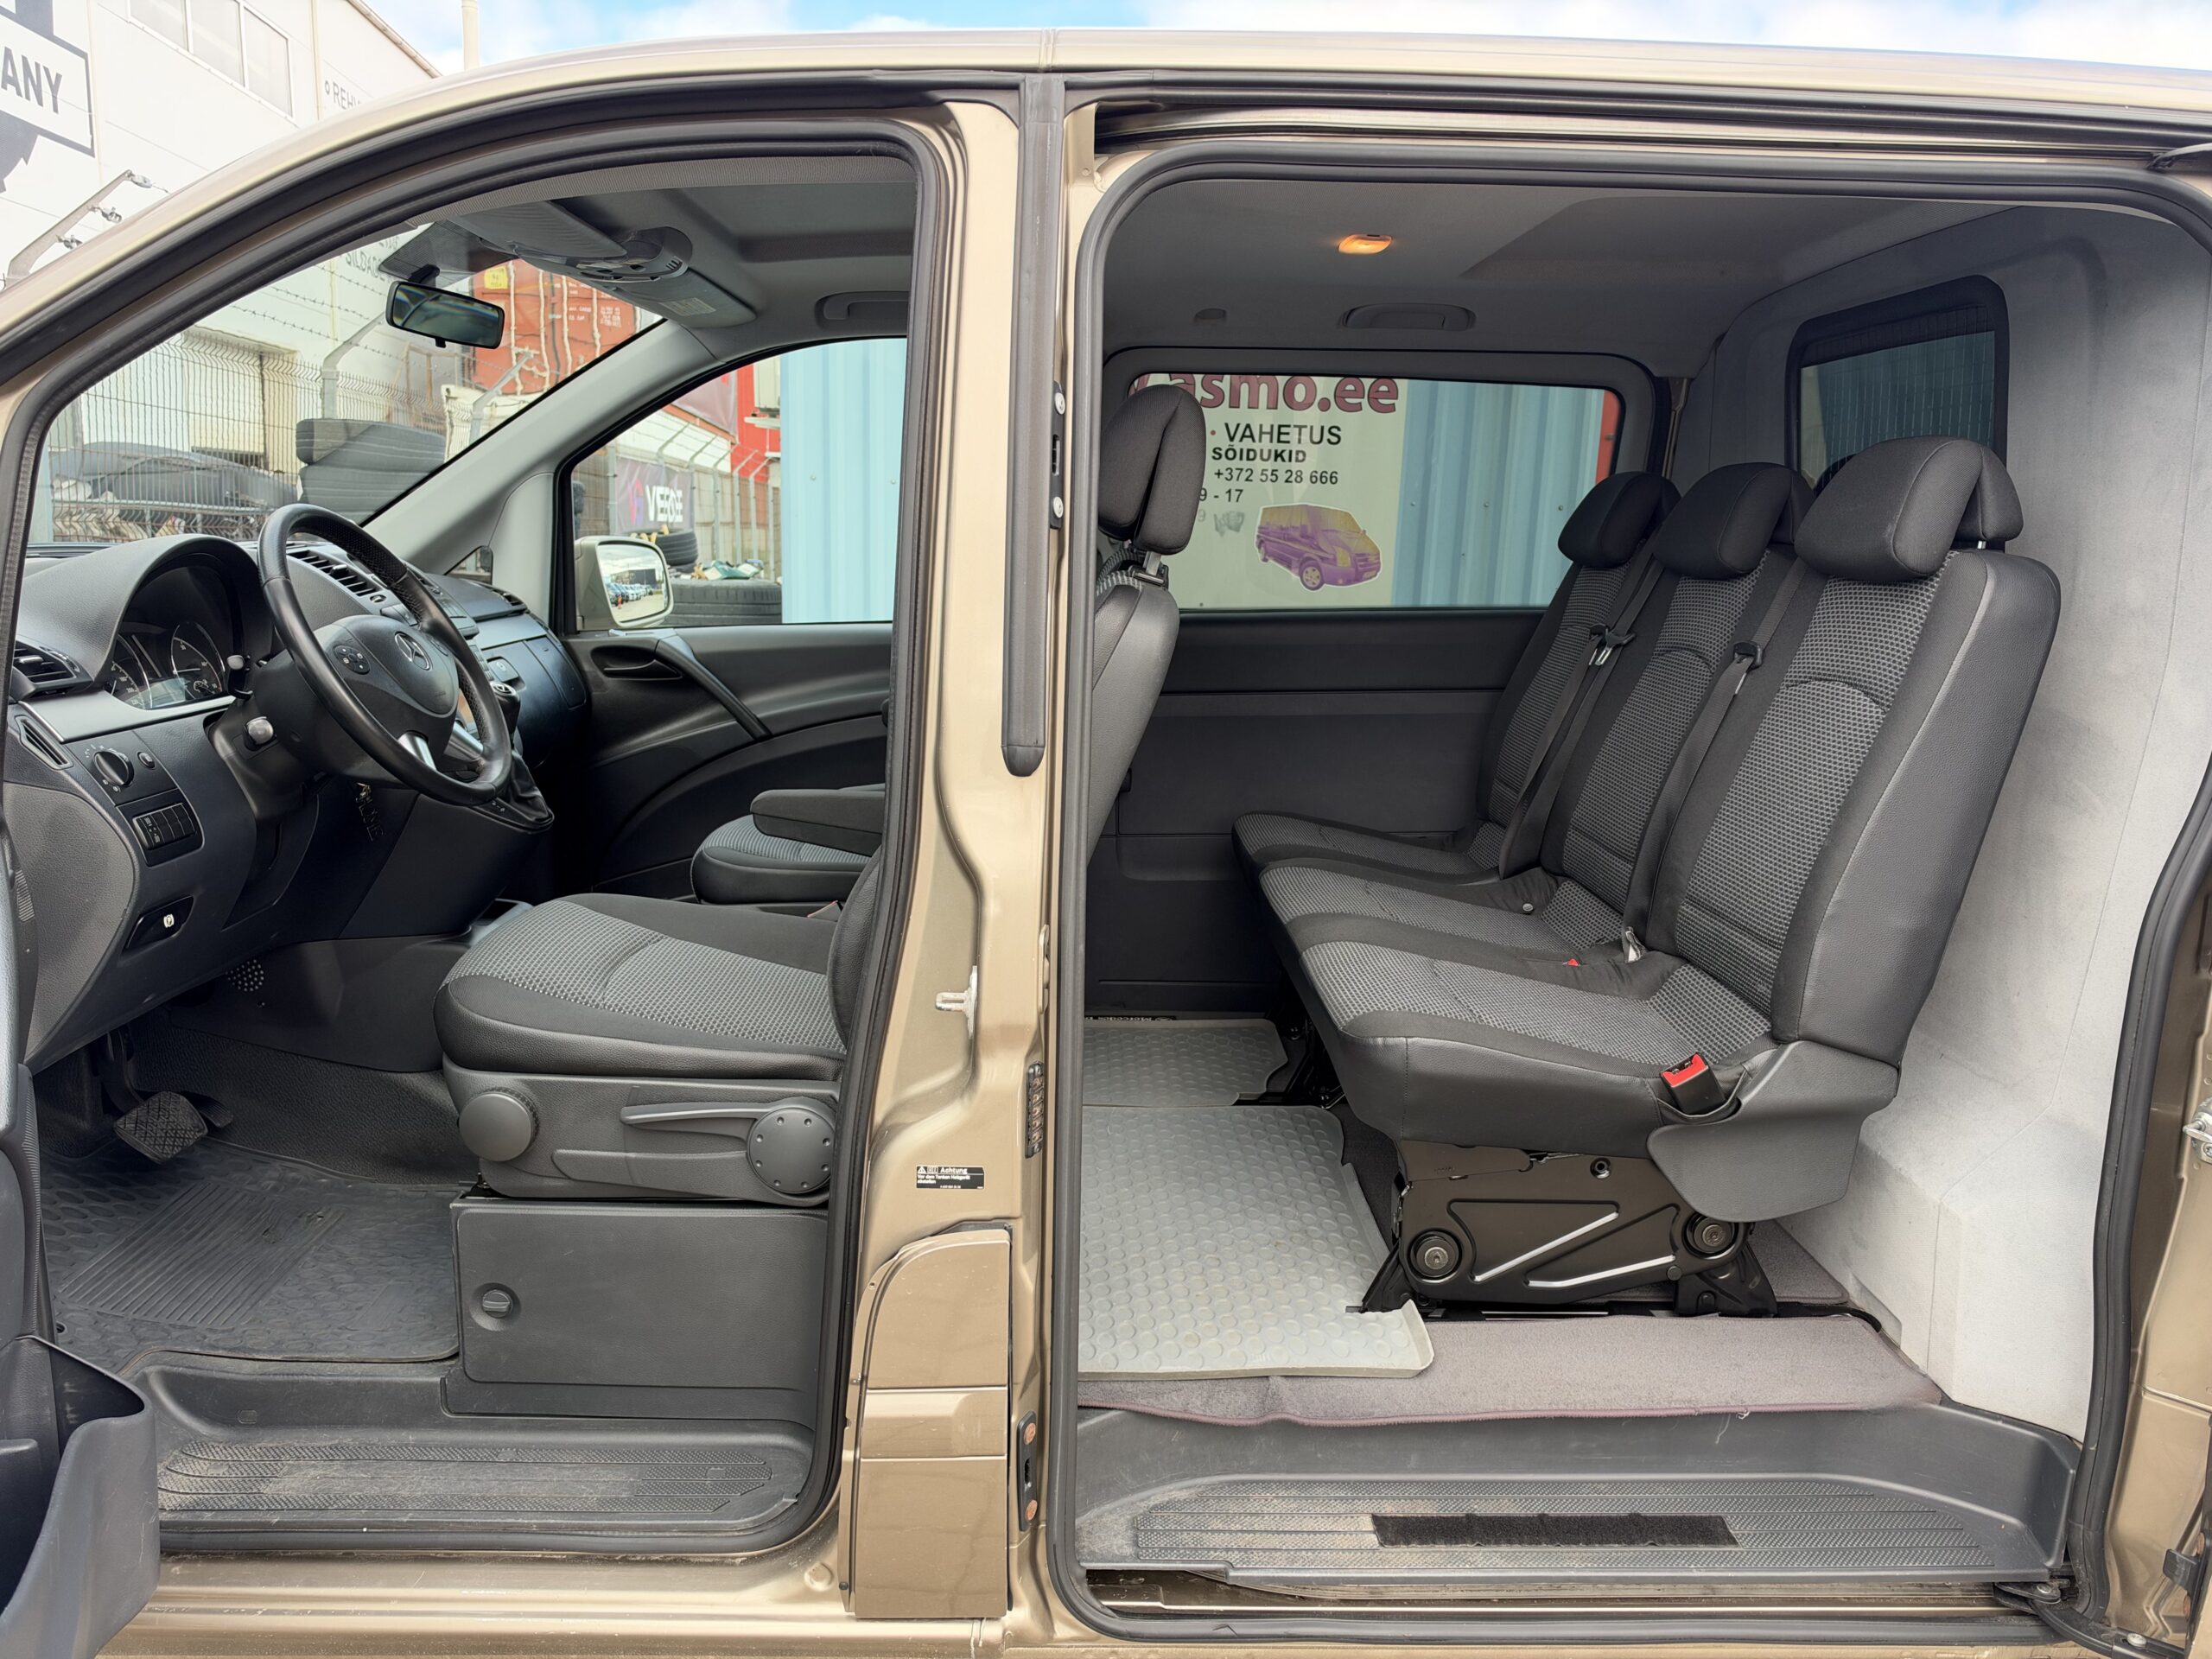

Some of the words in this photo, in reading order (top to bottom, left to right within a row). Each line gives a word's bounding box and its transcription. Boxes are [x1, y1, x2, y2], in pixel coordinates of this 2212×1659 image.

[1224, 423, 1343, 446] VAHETUS
[1211, 444, 1307, 463] SÕIDUKID
[1214, 467, 1254, 482] +372
[1260, 469, 1279, 483] 55
[1284, 470, 1304, 484] 28
[1309, 471, 1338, 485] 666
[1225, 488, 1244, 502] 17
